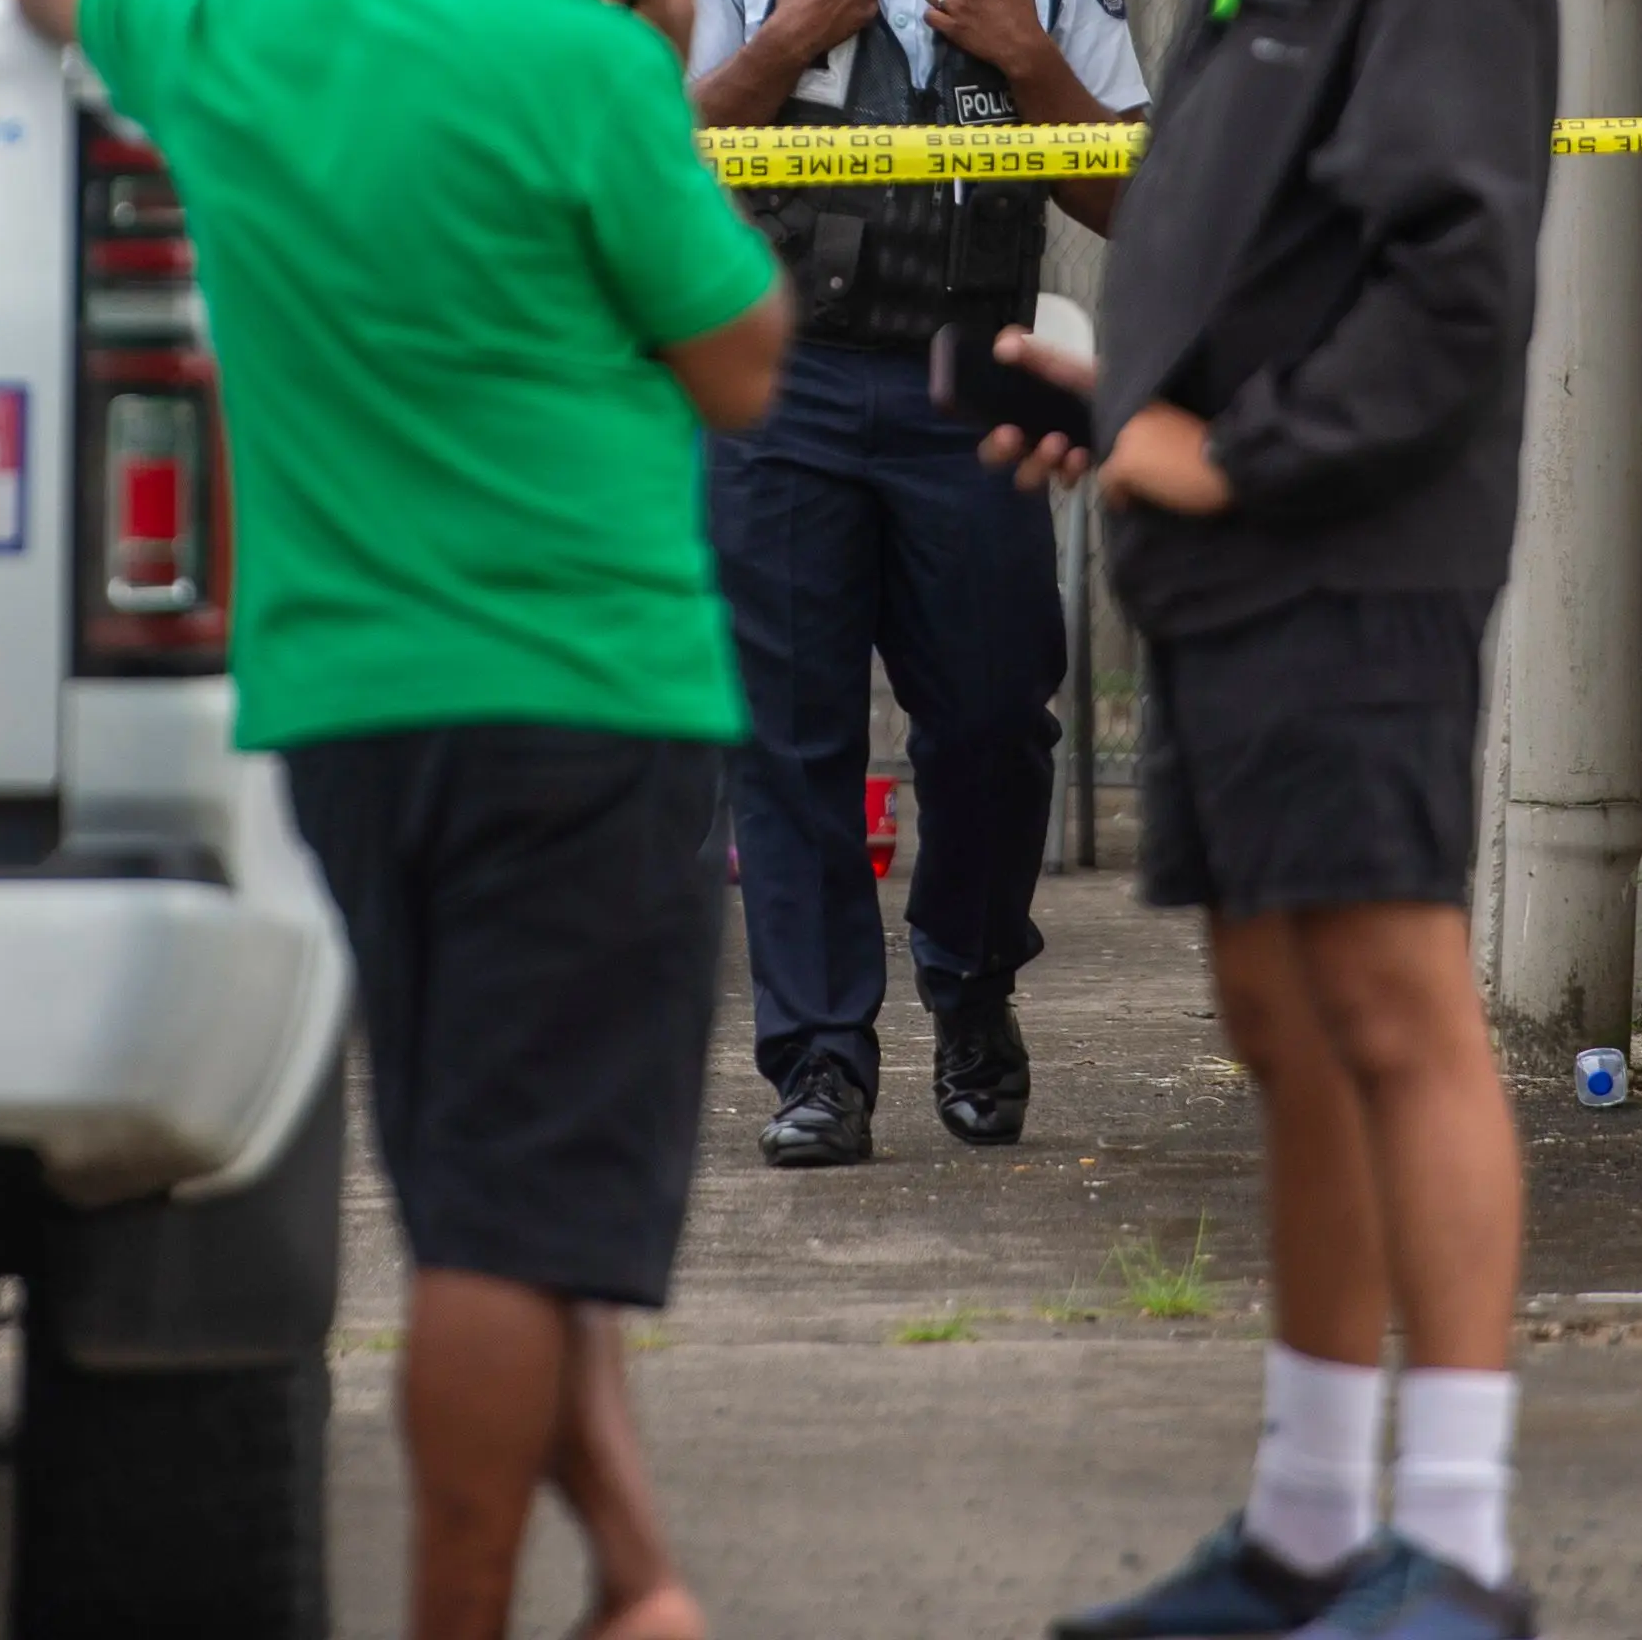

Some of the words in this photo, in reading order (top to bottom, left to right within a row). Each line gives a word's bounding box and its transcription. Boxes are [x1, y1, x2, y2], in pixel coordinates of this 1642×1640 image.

[772, 135, 835, 149] NOT
[850, 134, 893, 148] DO
[925, 132, 1035, 147] CROSS
[1048, 131, 1111, 144] NOT
[785, 153, 894, 177] CRIME
[927, 151, 1046, 174] SCENE
